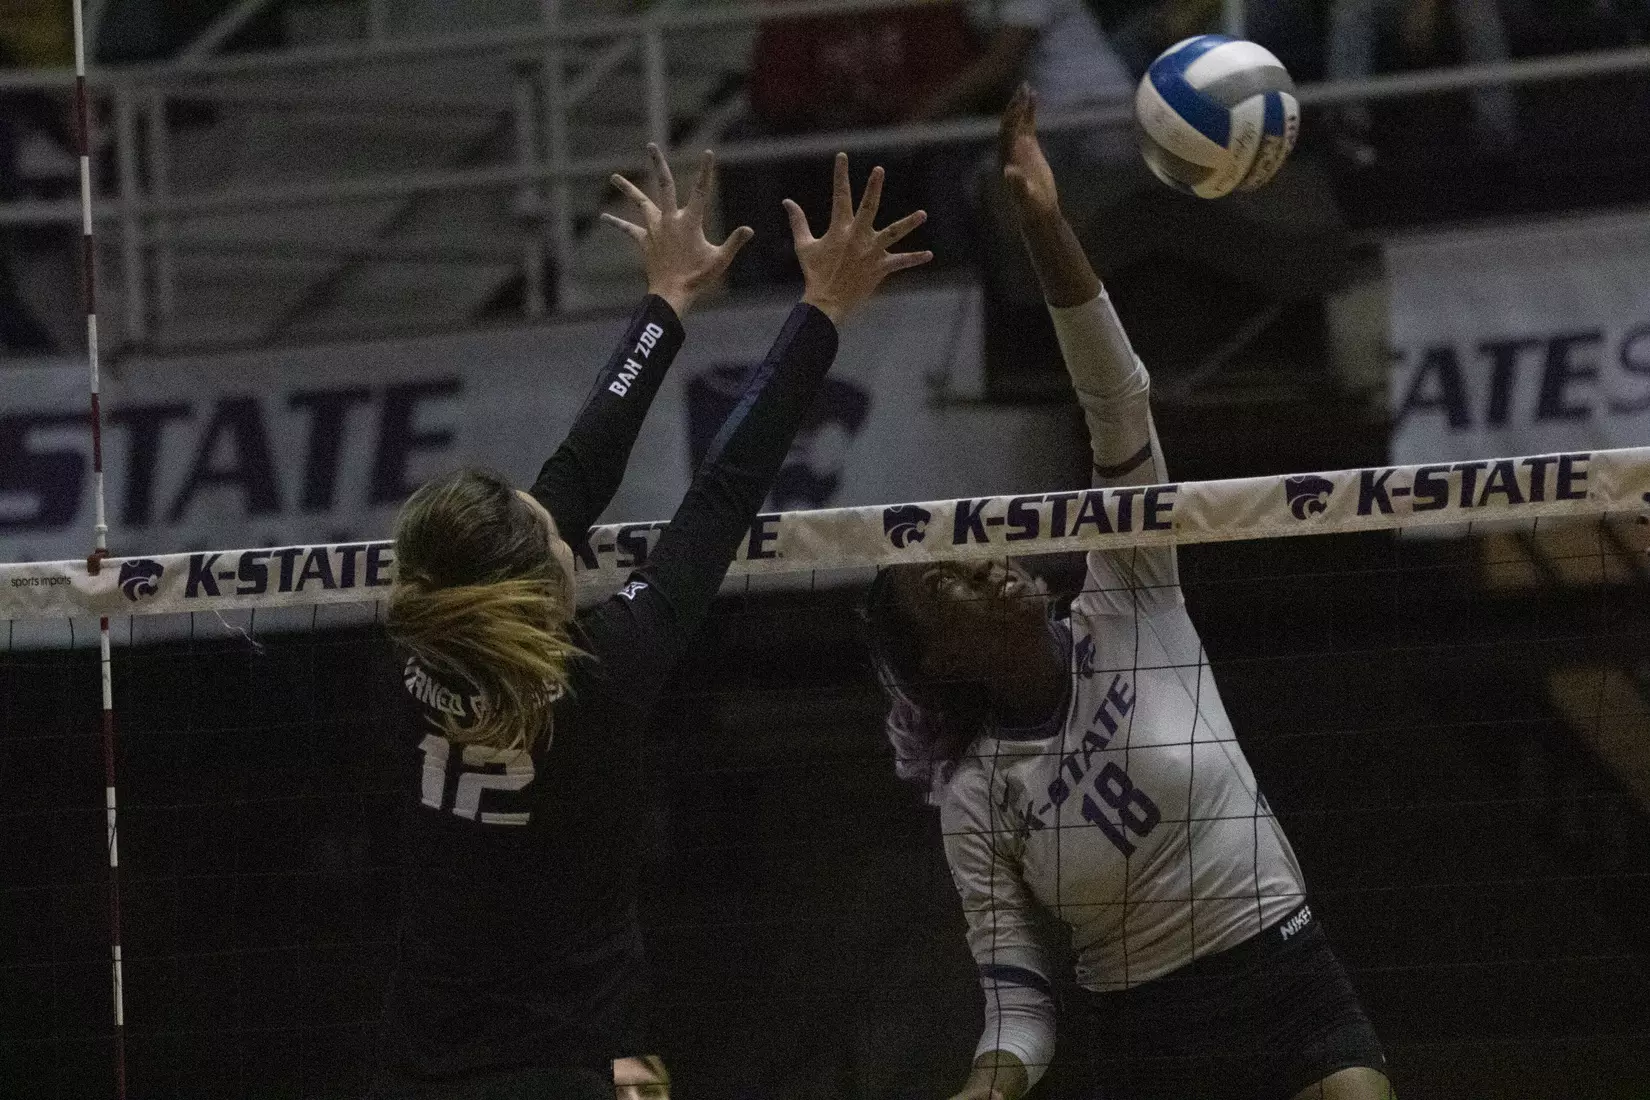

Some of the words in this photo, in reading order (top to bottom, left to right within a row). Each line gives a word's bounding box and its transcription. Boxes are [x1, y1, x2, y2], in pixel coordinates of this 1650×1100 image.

[608, 358, 643, 397] BAH
[634, 322, 664, 359] ZOO
[952, 485, 1178, 545] K-STATE
[1356, 453, 1591, 516] K-STATE
[11, 577, 39, 588] sports
[41, 575, 71, 587] imports
[185, 543, 394, 598] K-STATE
[418, 733, 535, 825] 12
[1081, 761, 1161, 857] 18
